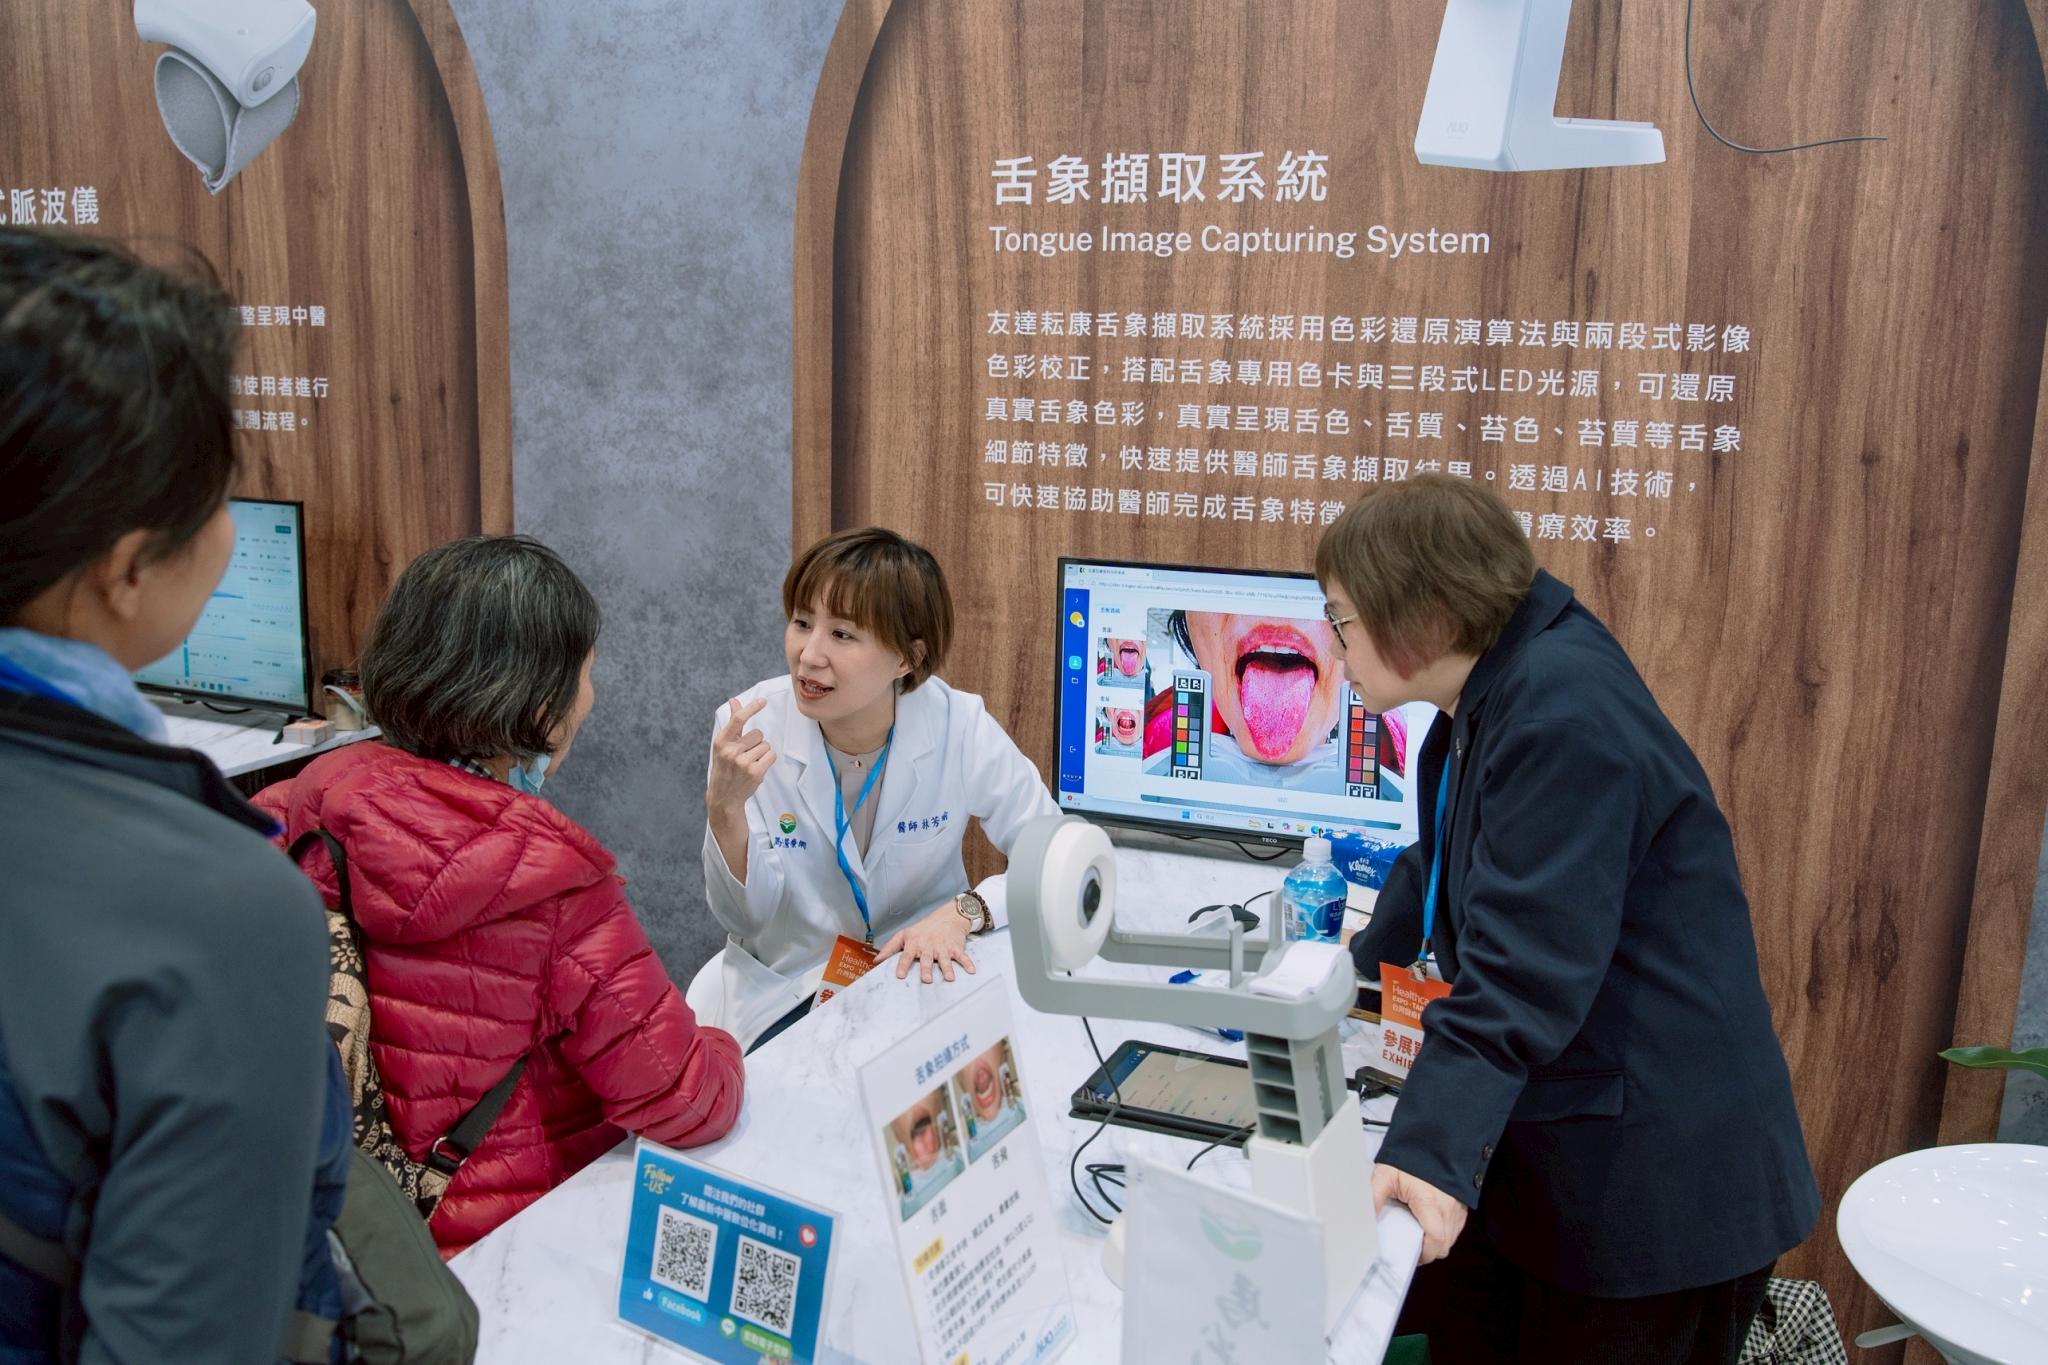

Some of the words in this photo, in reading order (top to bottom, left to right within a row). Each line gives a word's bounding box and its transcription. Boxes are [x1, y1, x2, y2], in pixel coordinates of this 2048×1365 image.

[990, 149, 1331, 206] 舌象擷取系統
[0, 186, 99, 225] 脈波儀
[989, 225, 1093, 257] Tongue
[1101, 224, 1192, 257] Image
[1200, 224, 1359, 259] Capturing
[1366, 224, 1490, 260] System
[987, 309, 1751, 354] 友達耘康舌象擷取系統採用色彩還原演算法與兩段式影像
[897, 821, 918, 833] 醫師
[1348, 860, 1377, 877] Kleenex
[839, 962, 854, 970] EXPO
[841, 953, 874, 970] Healthc
[1392, 985, 1430, 1006] Healthca
[1392, 996, 1408, 1006] EXPO
[643, 1162, 676, 1184] Follow
[661, 1296, 702, 1322] Facebook
